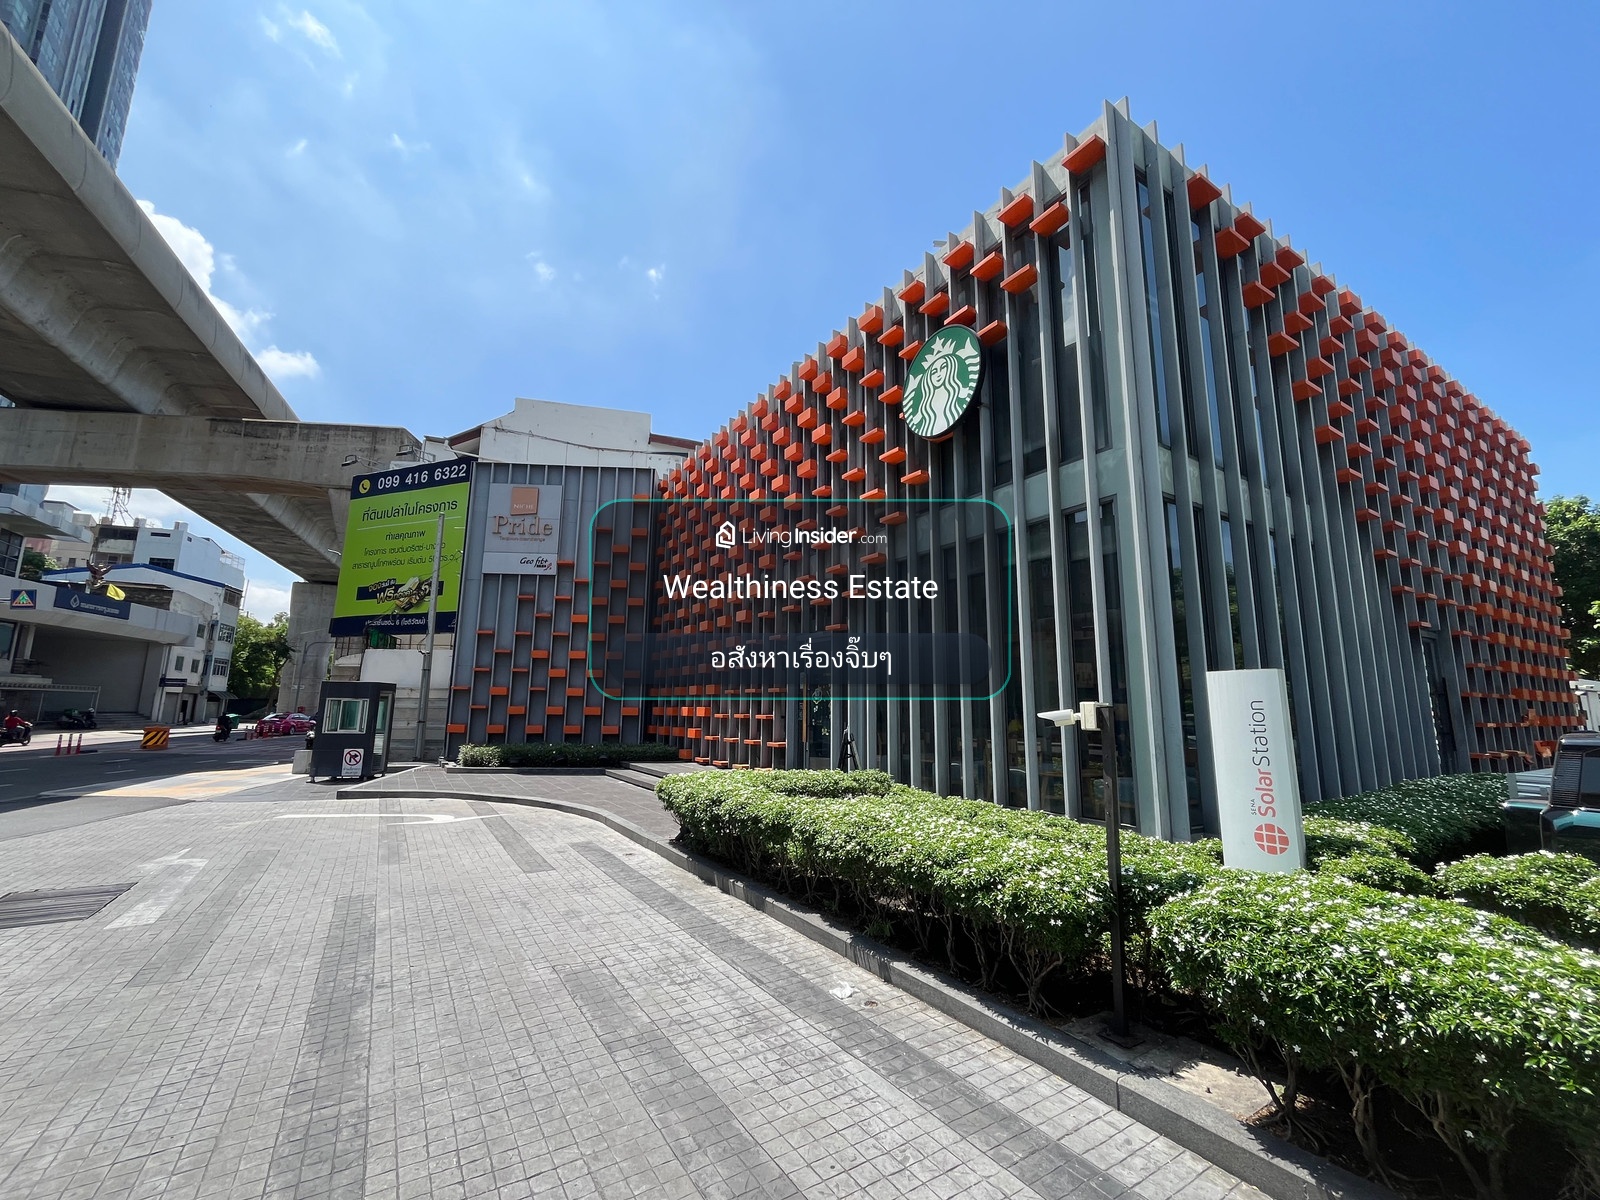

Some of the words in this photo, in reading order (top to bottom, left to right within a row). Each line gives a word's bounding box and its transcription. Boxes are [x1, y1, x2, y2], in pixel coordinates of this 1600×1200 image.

[378, 475, 400, 489] 099
[405, 471, 429, 485] 416
[434, 464, 467, 480] 6322
[362, 500, 458, 521] ที่ดินเปล่าในโครงการ
[492, 515, 553, 536] Pride
